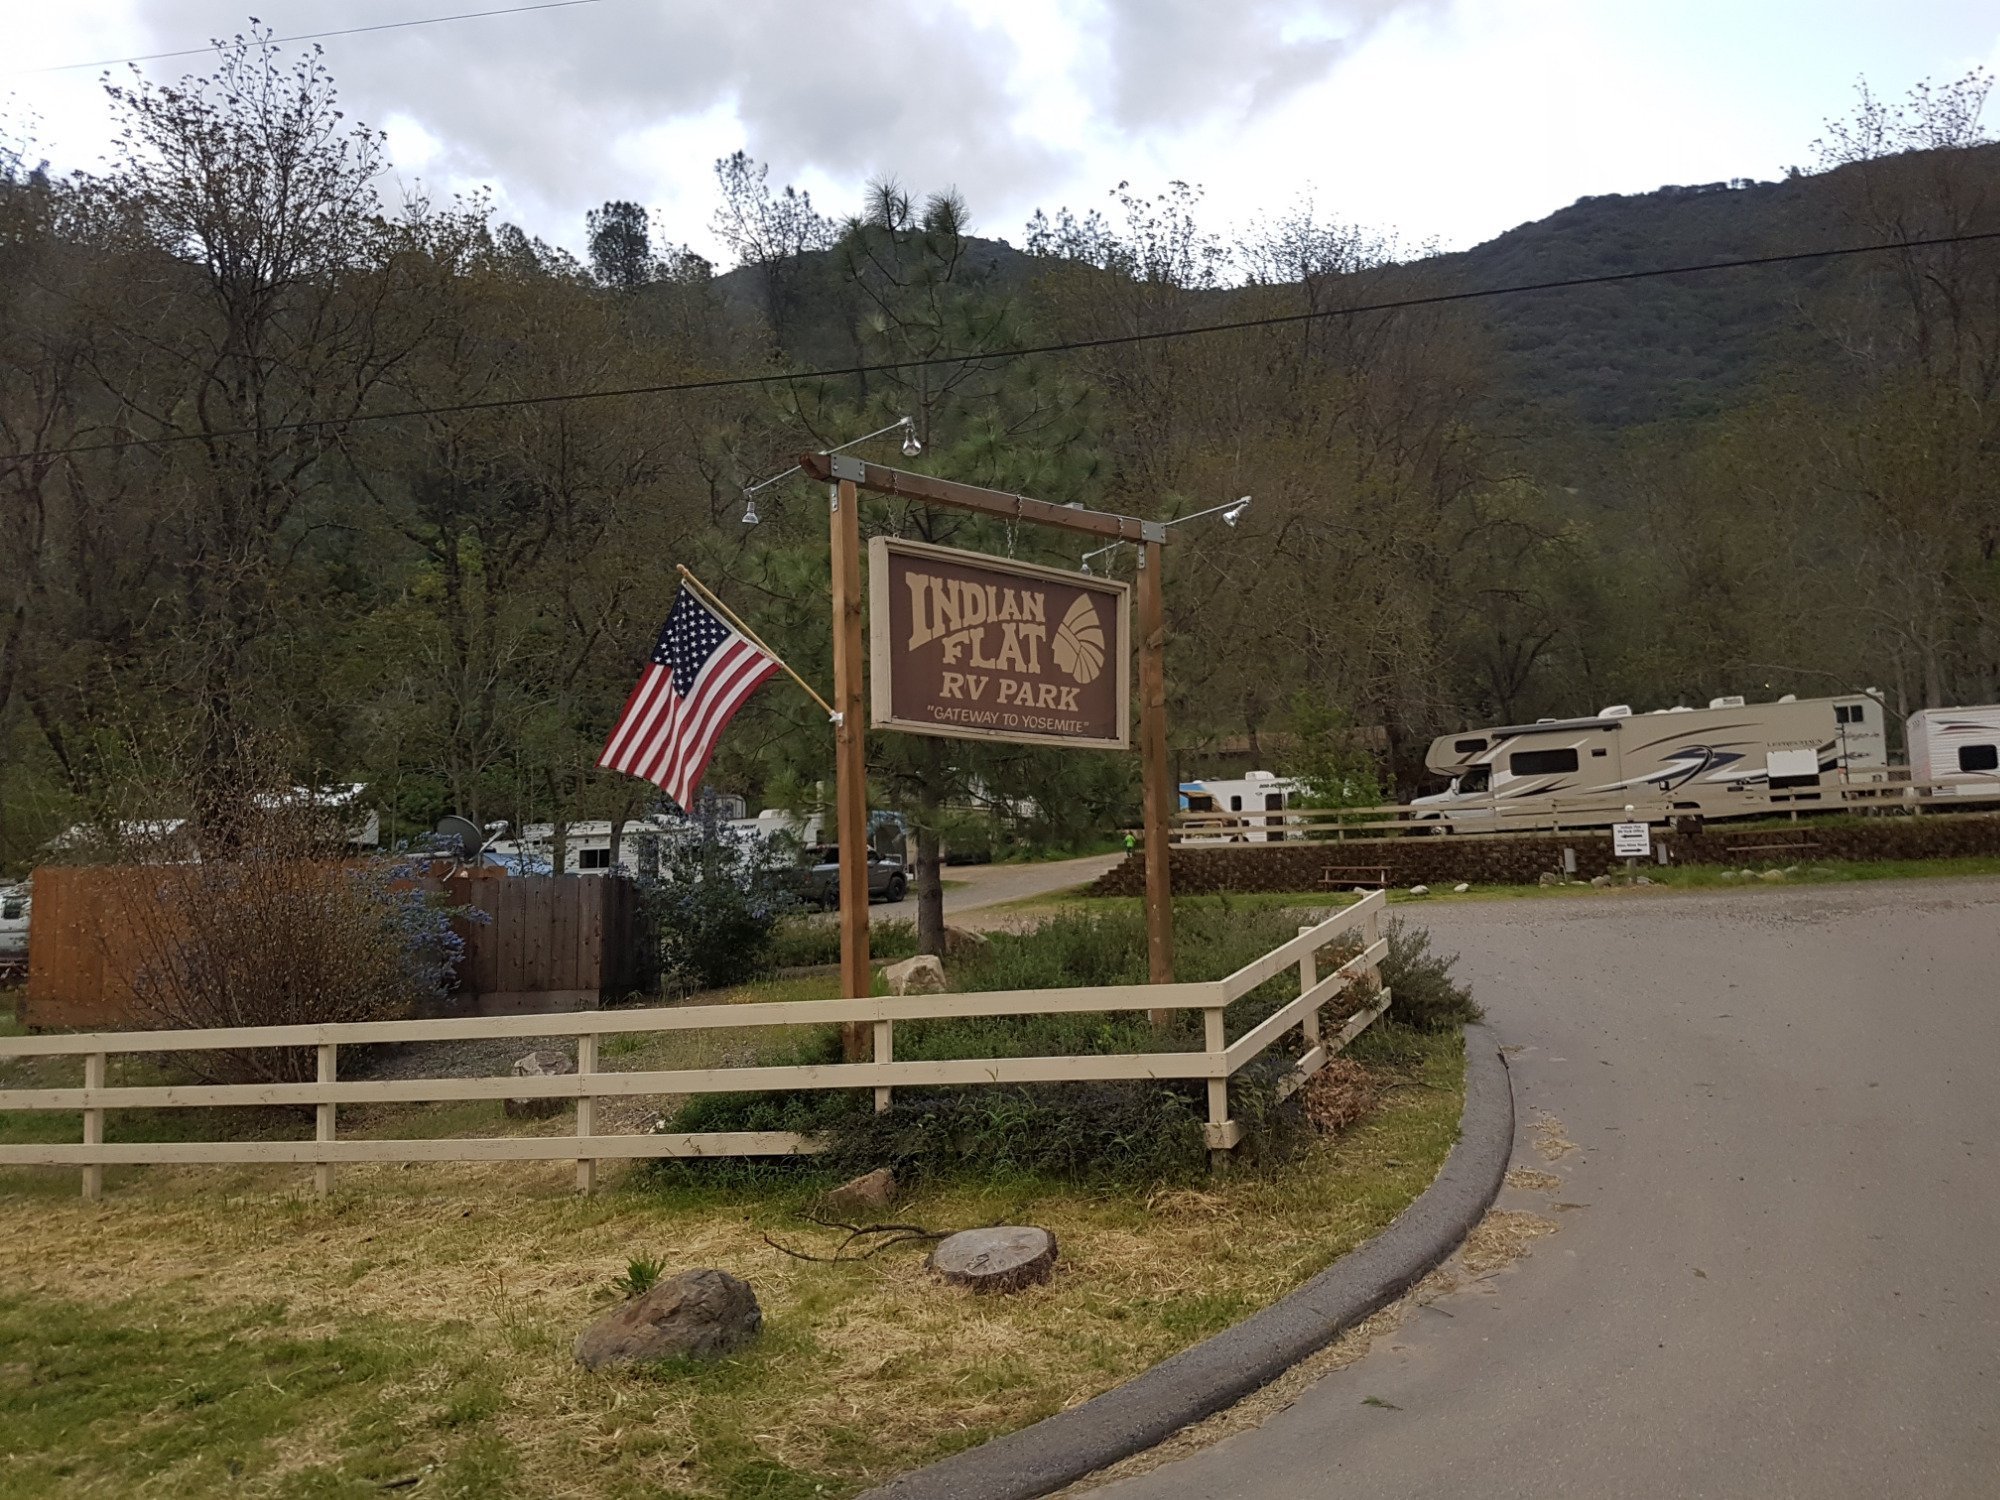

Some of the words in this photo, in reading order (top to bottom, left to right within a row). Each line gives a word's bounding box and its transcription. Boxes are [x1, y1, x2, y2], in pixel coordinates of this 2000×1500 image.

[905, 571, 1046, 652] INDIAN
[941, 622, 1046, 674] FLAT
[939, 671, 989, 700] RV
[996, 678, 1081, 712] PARK
[926, 704, 999, 724] "GATEWAY
[1003, 713, 1018, 727] TO
[1021, 715, 1089, 733] YOSEMITE"
